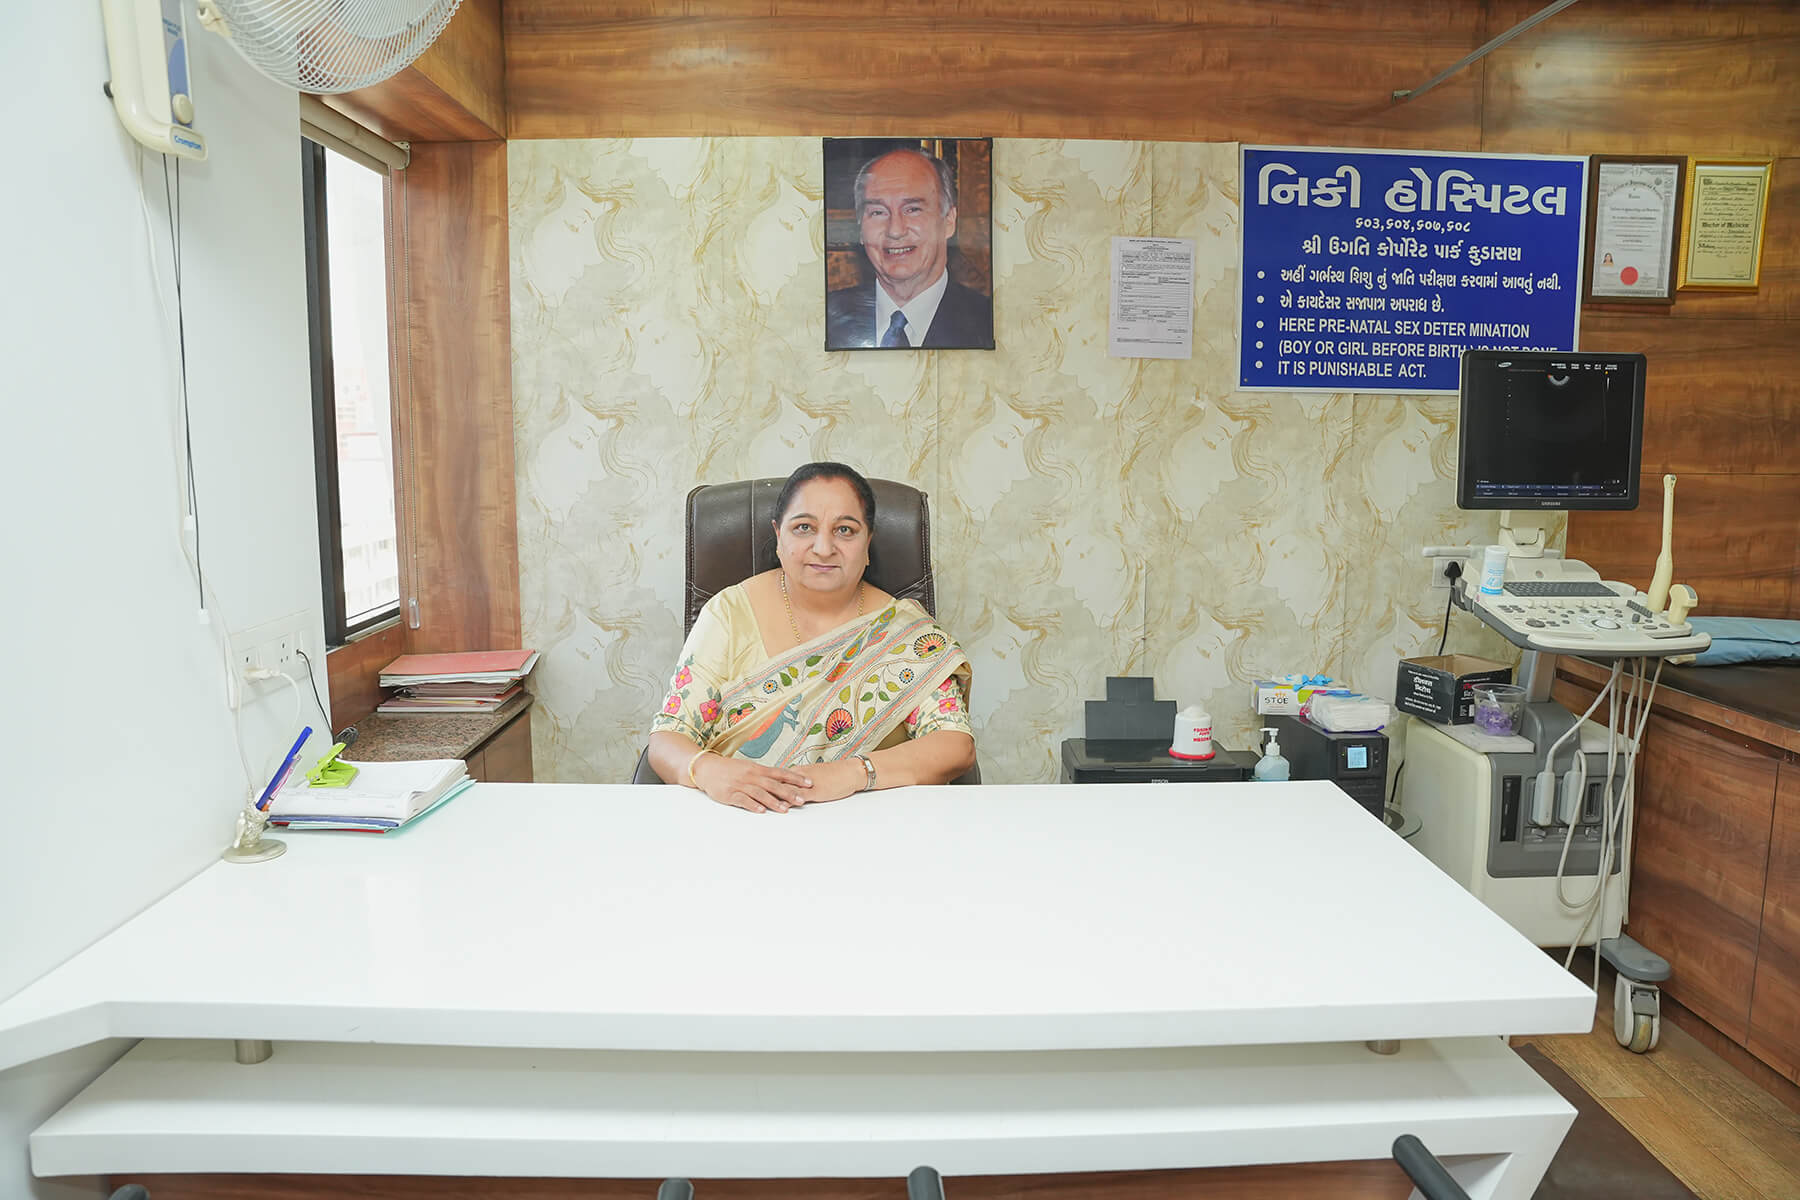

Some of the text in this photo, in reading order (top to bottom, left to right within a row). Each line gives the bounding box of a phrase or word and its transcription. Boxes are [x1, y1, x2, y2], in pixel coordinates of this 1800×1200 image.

[1257, 162, 1568, 216] નિકી હોસ્પિટલ
[1301, 234, 1322, 255] શ્રી
[1328, 236, 1370, 256] ઉગતિ
[1434, 239, 1464, 259] પાર્ક
[1468, 243, 1522, 266] કુડાસણ
[1280, 264, 1306, 283] અહીં
[1350, 266, 1373, 290] શિશુ
[1377, 268, 1388, 290] નું
[1391, 268, 1415, 285] જાતિ
[1419, 269, 1456, 288] પરીક્ષણ
[1460, 272, 1498, 288] કરવામાં
[1502, 273, 1534, 295] આવતું
[1280, 289, 1292, 308] એ
[1297, 290, 1341, 309] કાયદેસર
[1390, 297, 1427, 312] અપરાધ
[1279, 317, 1529, 338] HERE PRE-NATAL SEX DETER MINATION
[1279, 340, 1311, 356] (BOY
[1315, 340, 1334, 354] OR
[1338, 341, 1368, 356] GIRL
[1372, 342, 1425, 357] BEFORE
[1278, 361, 1426, 378] IT IS PUNISHABLE ACT.
